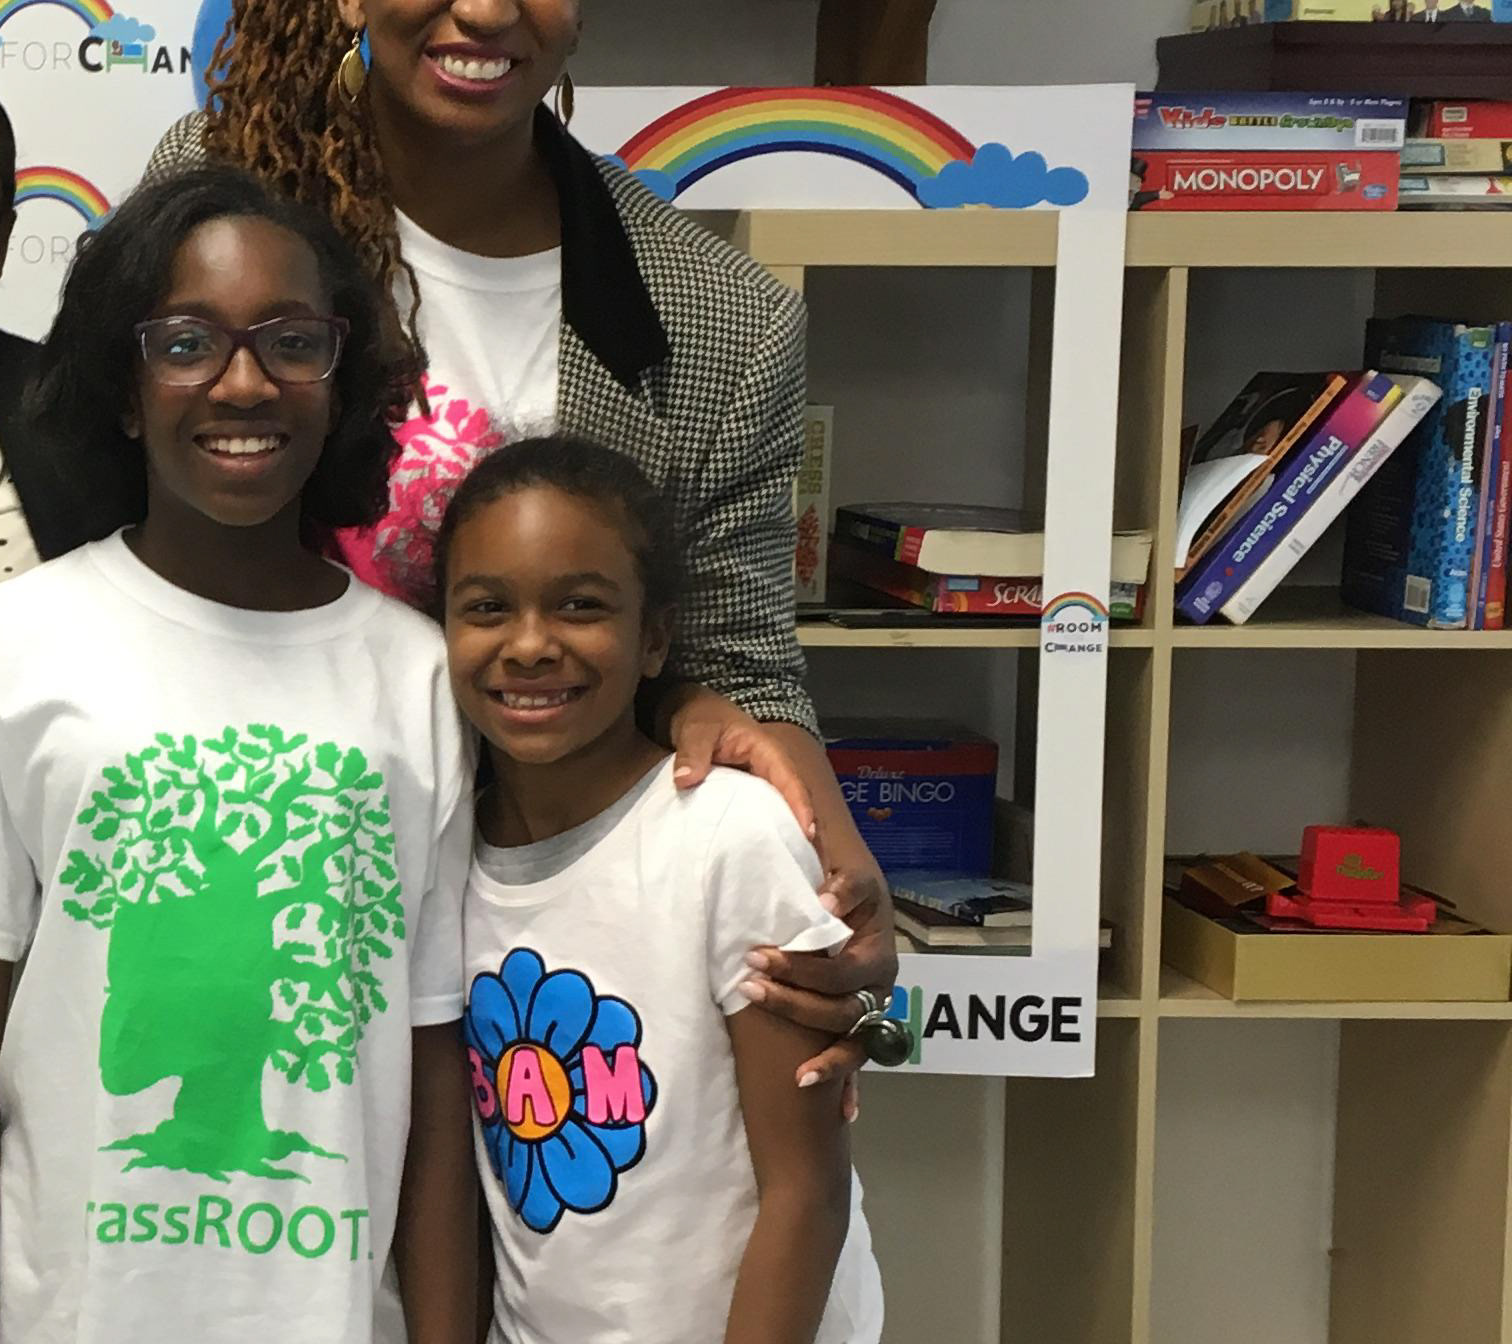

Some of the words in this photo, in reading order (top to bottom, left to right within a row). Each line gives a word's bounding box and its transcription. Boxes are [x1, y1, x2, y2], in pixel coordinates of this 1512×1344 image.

[1173, 167, 1324, 191] MONOPOLY
[1461, 387, 1481, 484] Environmental
[1282, 435, 1345, 505] Physical
[1232, 501, 1288, 563] Science
[1455, 487, 1473, 543] Science
[986, 582, 1044, 607] SCRA
[840, 781, 869, 802] GE
[879, 781, 955, 803] BINGO
[857, 765, 906, 780] Deluxe
